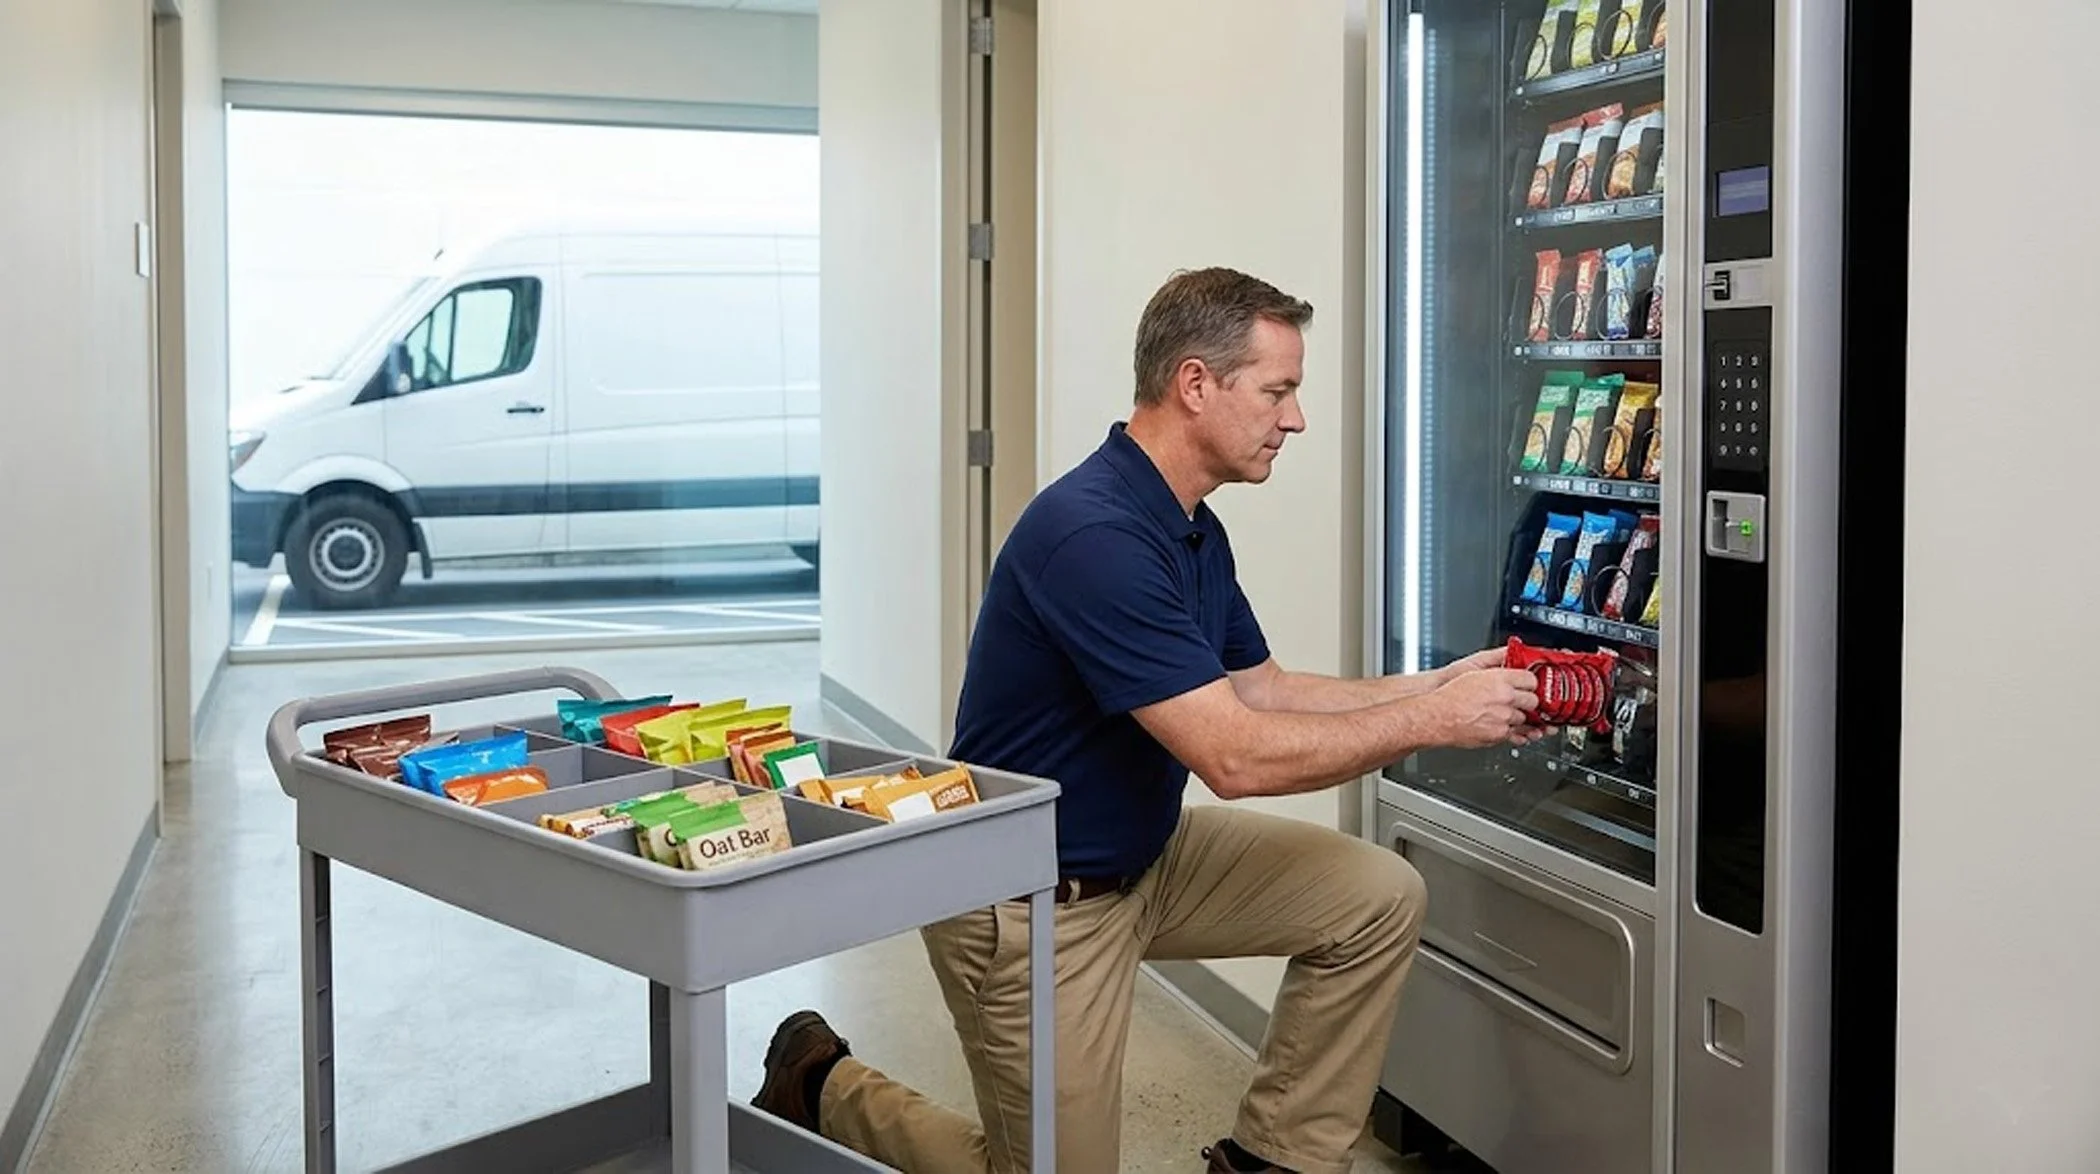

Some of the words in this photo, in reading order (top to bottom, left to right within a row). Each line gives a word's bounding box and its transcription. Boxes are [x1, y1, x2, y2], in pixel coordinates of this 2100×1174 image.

[1736, 355, 1742, 367] 2
[700, 836, 737, 858] Oat
[738, 829, 770, 849] Bar
